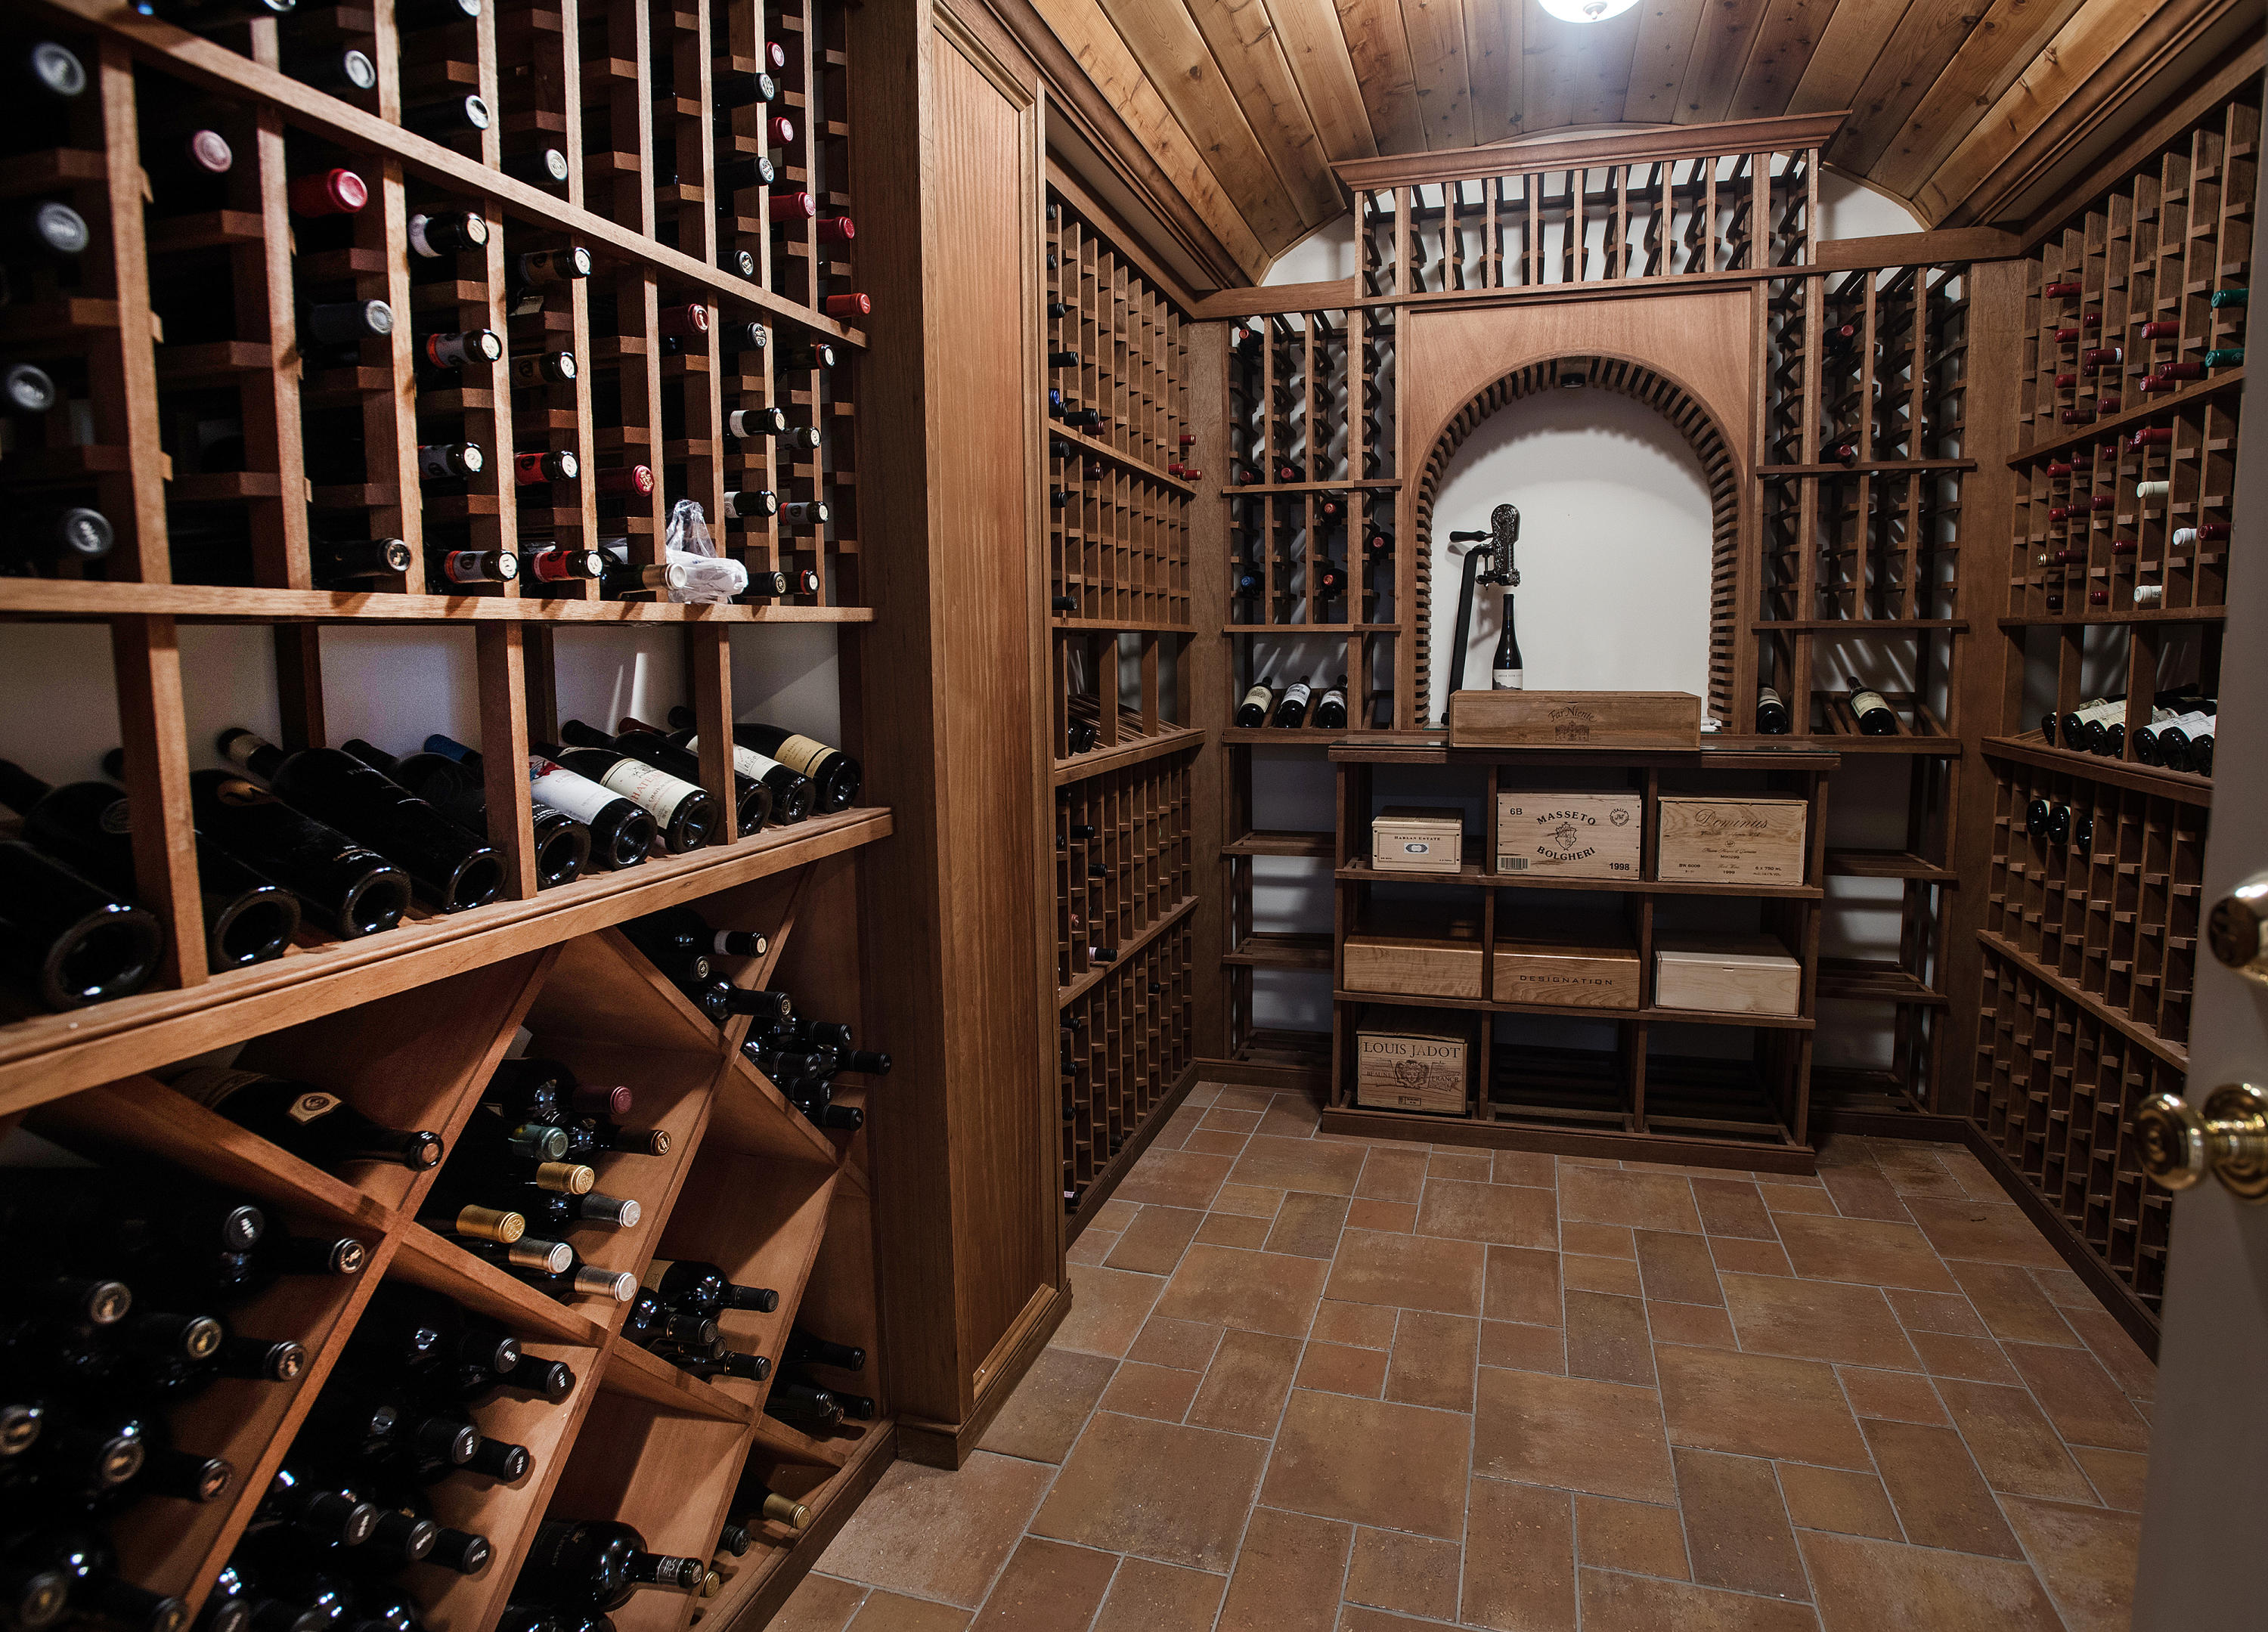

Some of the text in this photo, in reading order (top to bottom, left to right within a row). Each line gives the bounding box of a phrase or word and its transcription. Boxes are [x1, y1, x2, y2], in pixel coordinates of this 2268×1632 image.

[1548, 705, 1597, 723] Far Niente
[1510, 807, 1523, 816] 6B
[1536, 810, 1596, 825] MASSETO
[1693, 808, 1768, 829] Dominus
[1536, 845, 1596, 861] BOLGHERI
[1609, 862, 1630, 871] 1998
[1520, 975, 1613, 986] DESIGNATION
[1363, 1042, 1461, 1058] LOUIS JADOT
